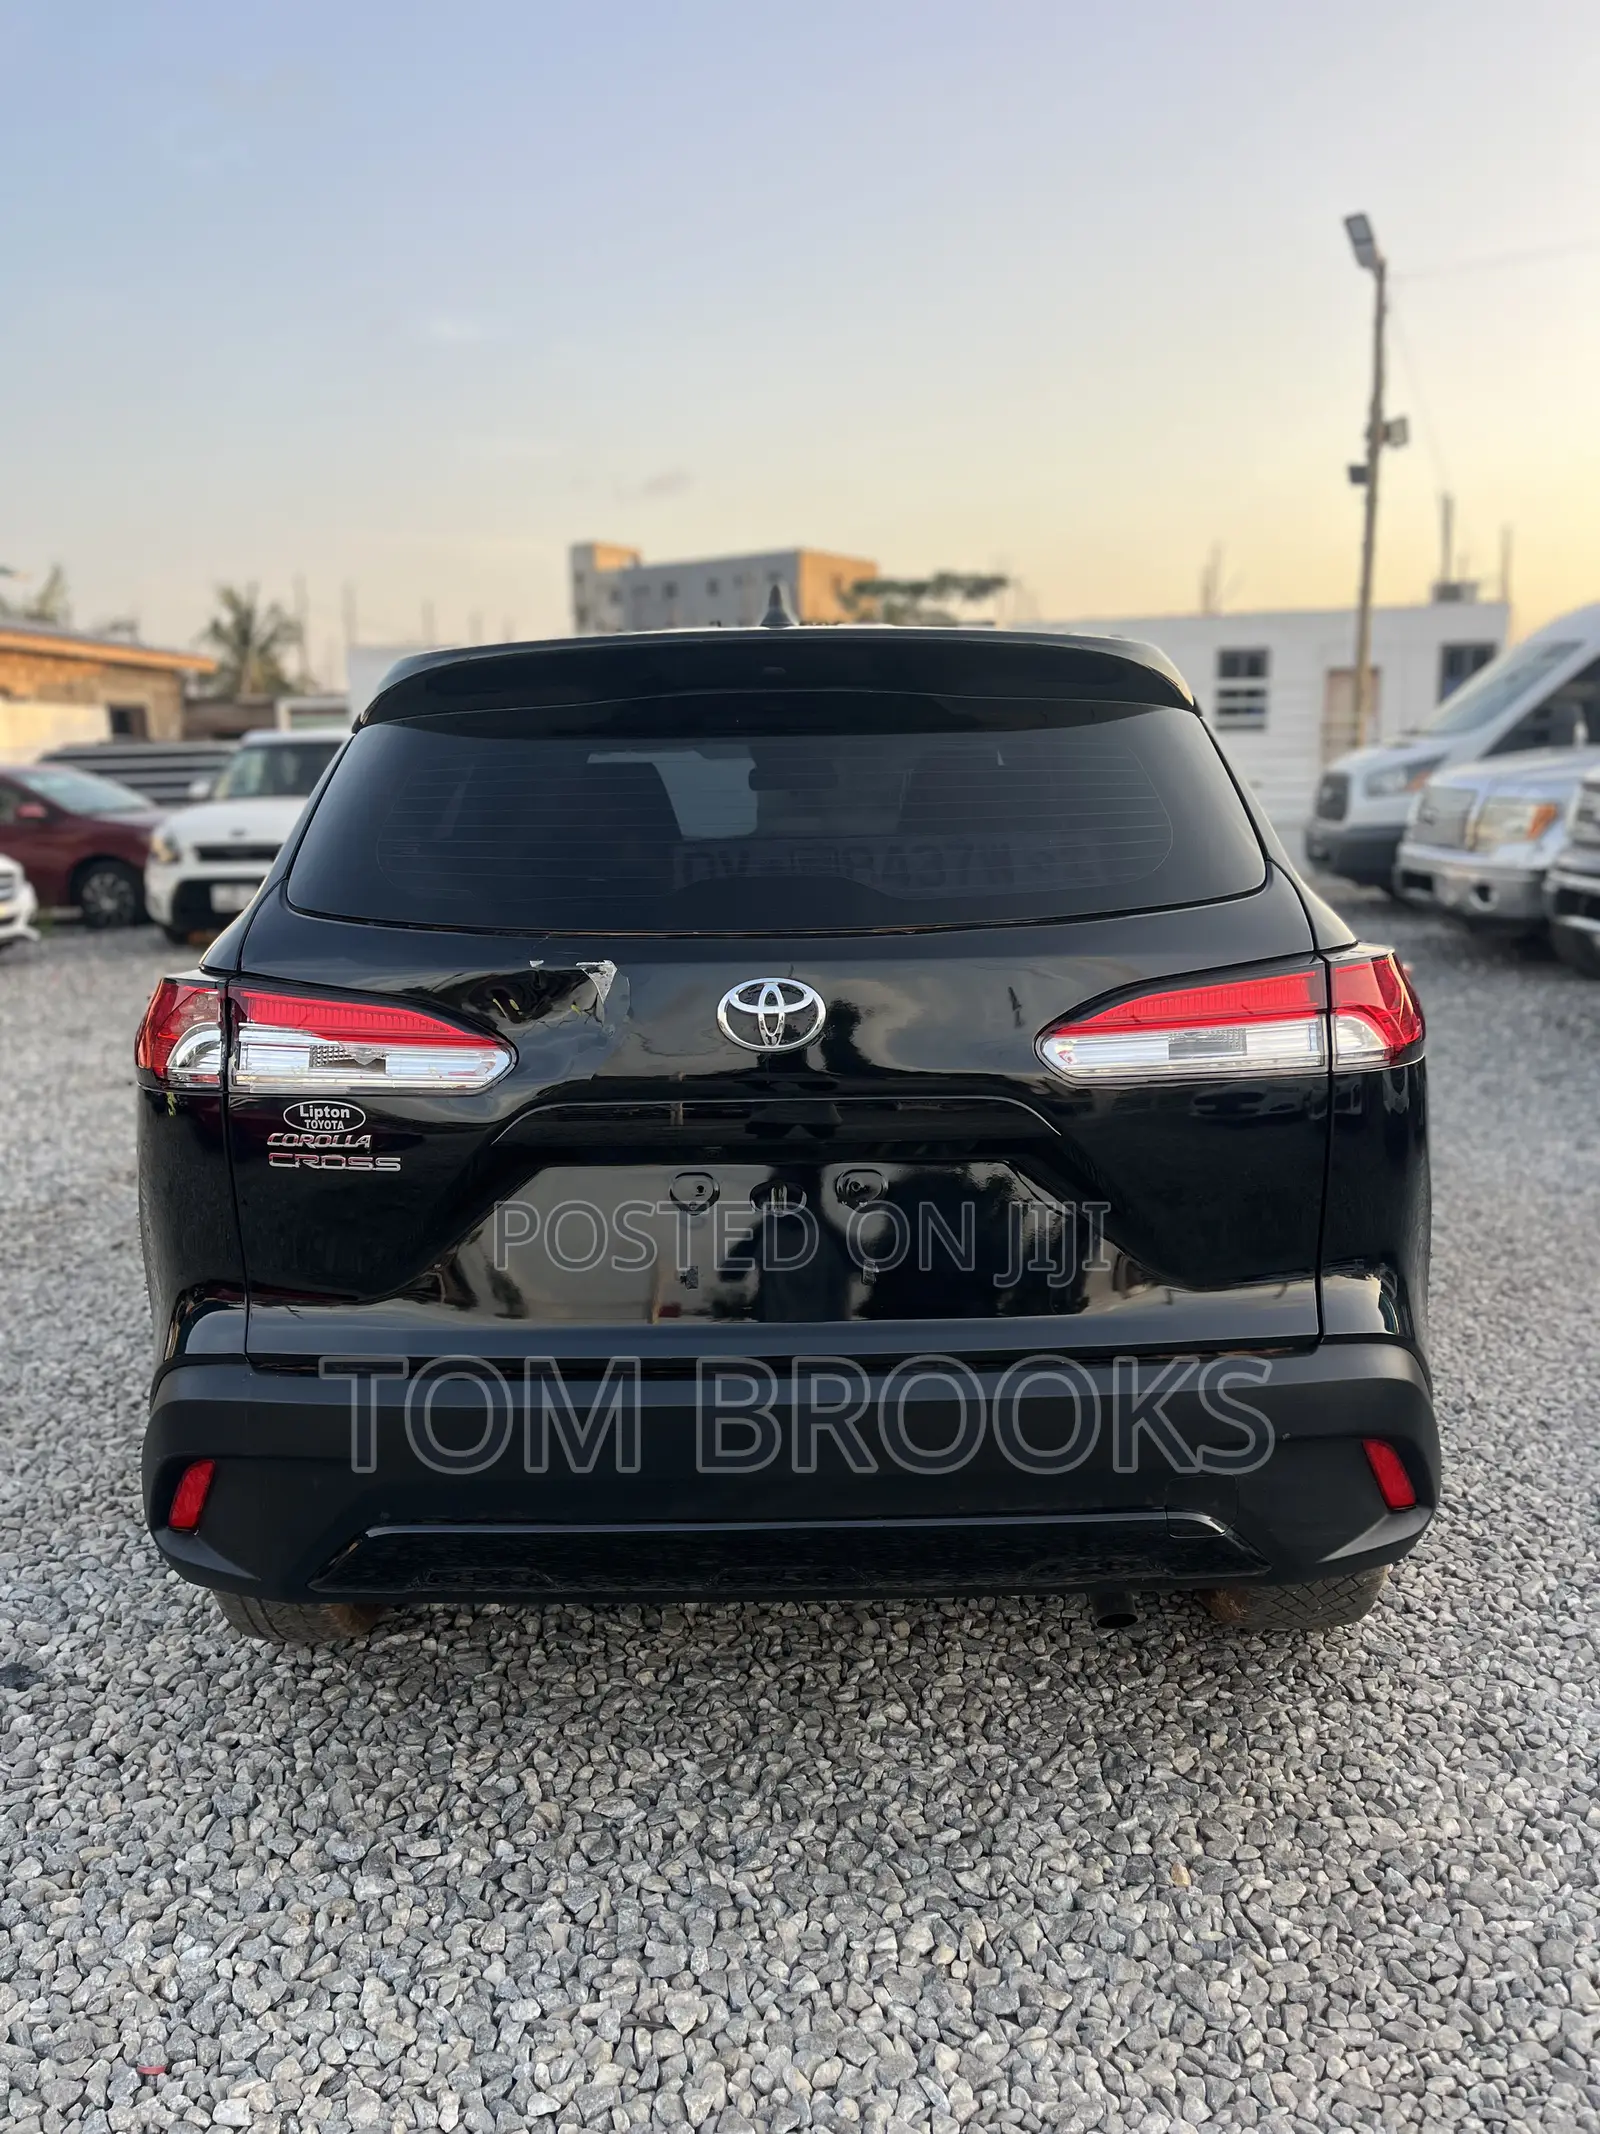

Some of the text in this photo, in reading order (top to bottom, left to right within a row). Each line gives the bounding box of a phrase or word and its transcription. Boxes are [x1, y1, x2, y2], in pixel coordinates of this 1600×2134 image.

[300, 1105, 350, 1120] Lipton
[304, 1120, 345, 1130] TOYOTA
[266, 1132, 372, 1149] COROLLA
[268, 1152, 401, 1172] CROSS
